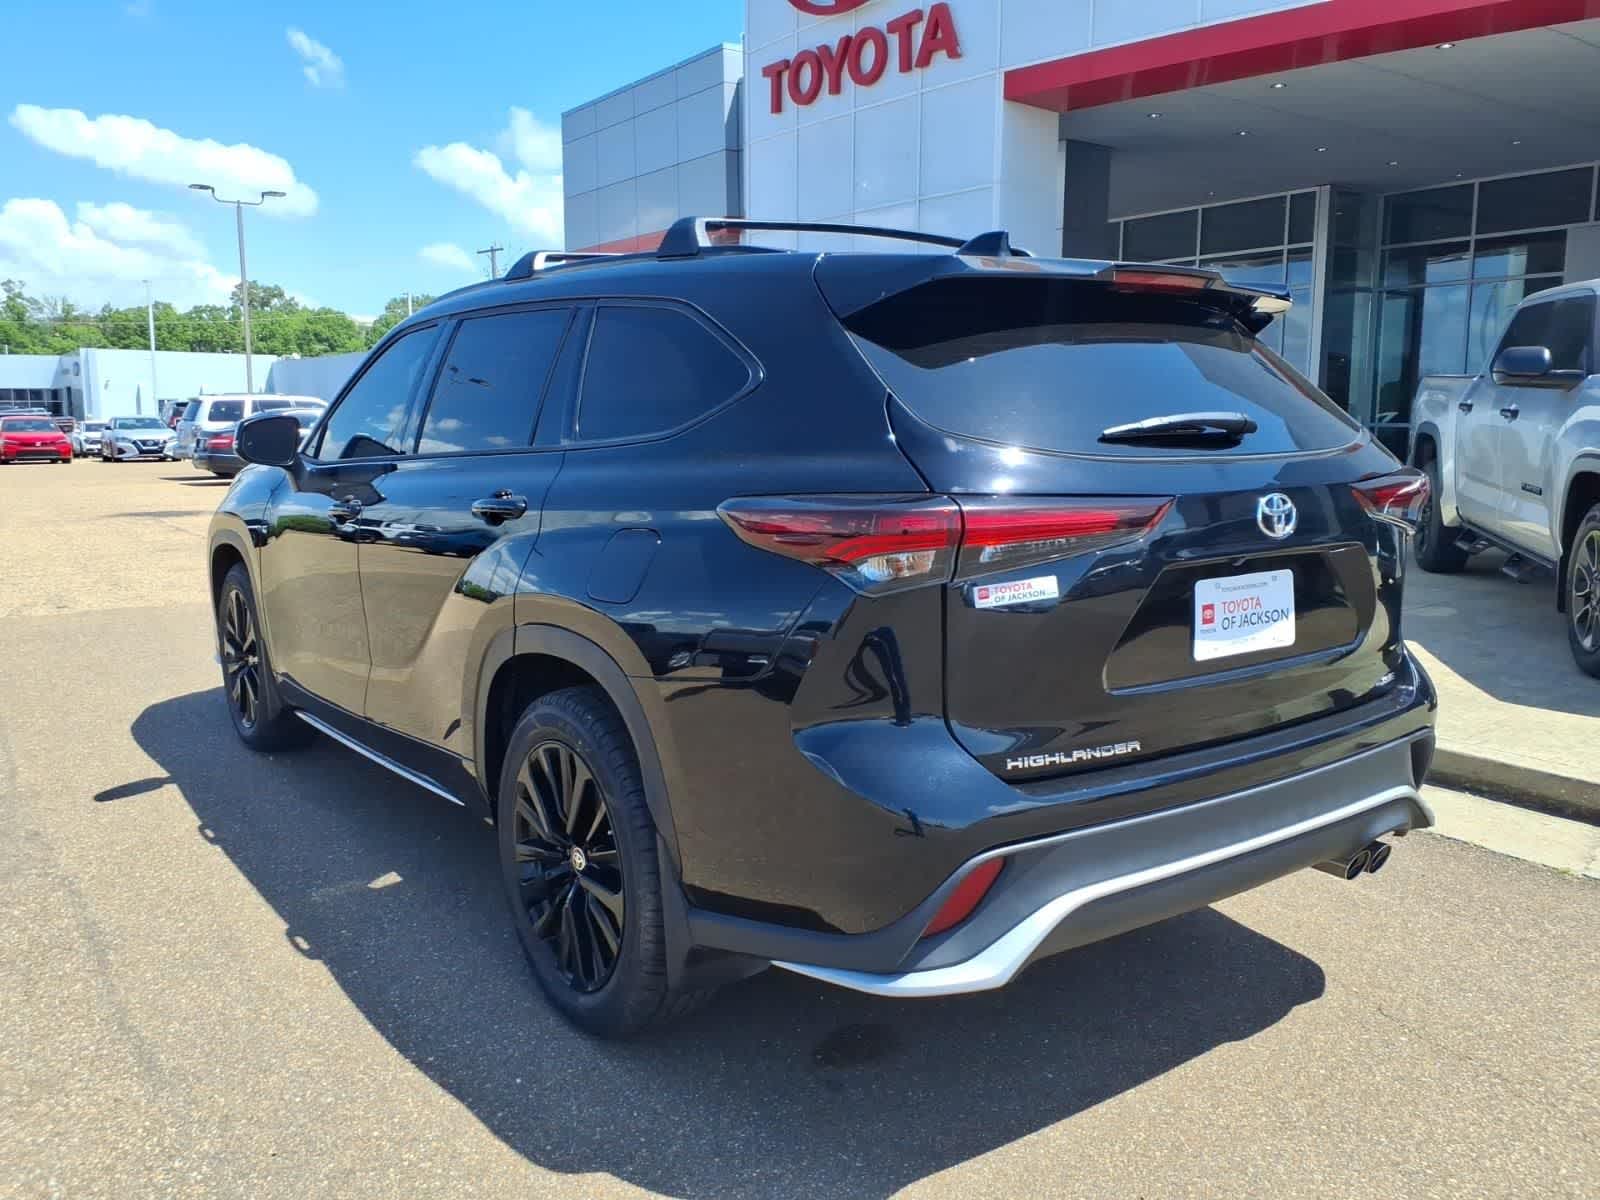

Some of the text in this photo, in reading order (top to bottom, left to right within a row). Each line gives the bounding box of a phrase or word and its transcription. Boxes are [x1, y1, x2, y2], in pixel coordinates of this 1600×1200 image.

[762, 2, 961, 114] TOYOTA
[994, 582, 1033, 594] TOYOTA
[1008, 590, 1046, 601] JACKSON
[1221, 597, 1262, 614] TOYOTA
[1221, 608, 1289, 630] OF JACKSON
[1006, 740, 1141, 770] HIGHLANDER
